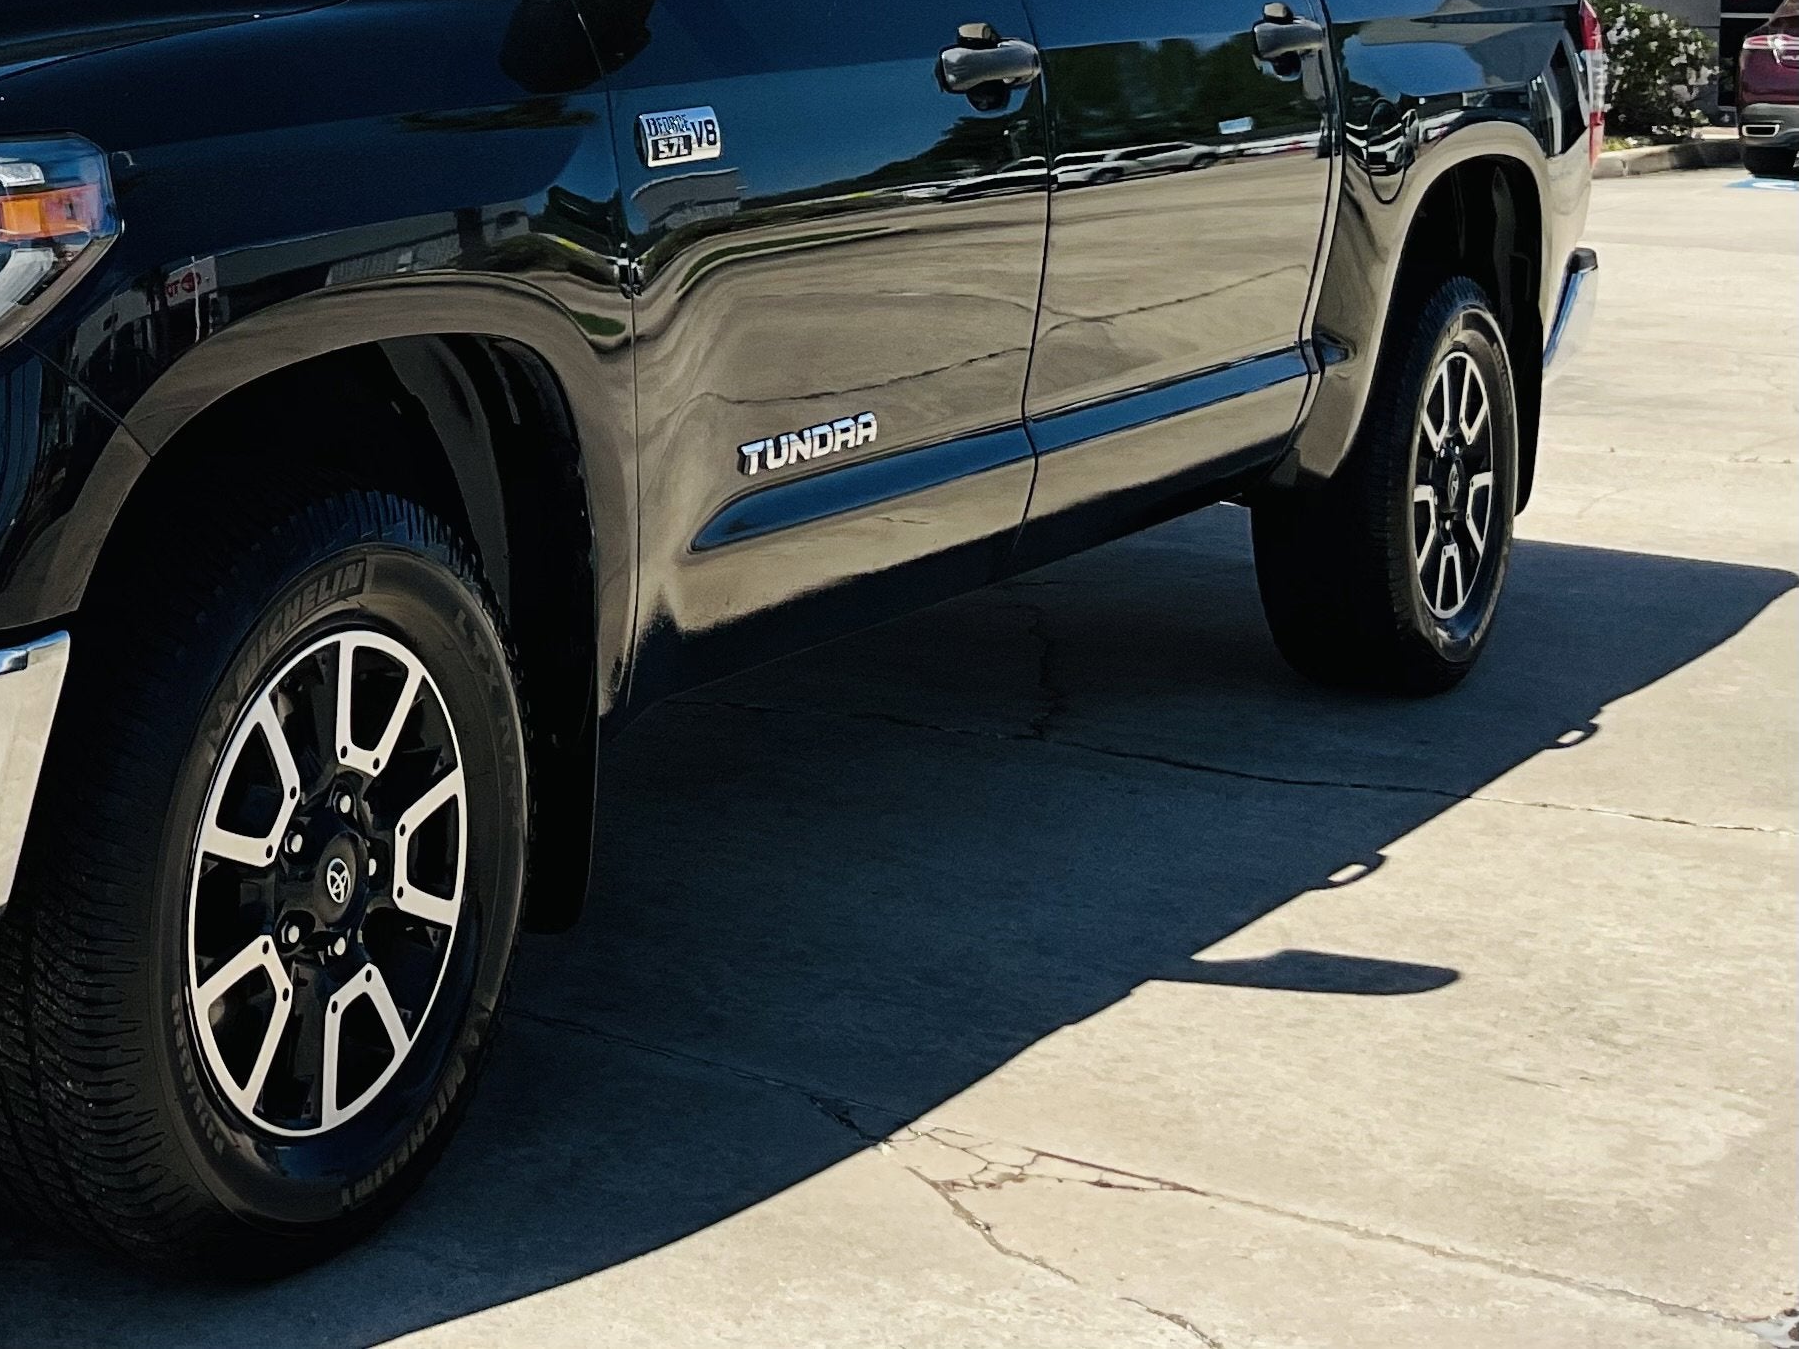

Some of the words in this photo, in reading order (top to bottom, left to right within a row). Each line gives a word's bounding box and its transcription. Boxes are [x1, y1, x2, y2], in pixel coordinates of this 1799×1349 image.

[690, 119, 717, 147] V8
[737, 411, 878, 476] TUNDRA
[235, 560, 366, 698] MICHELIN
